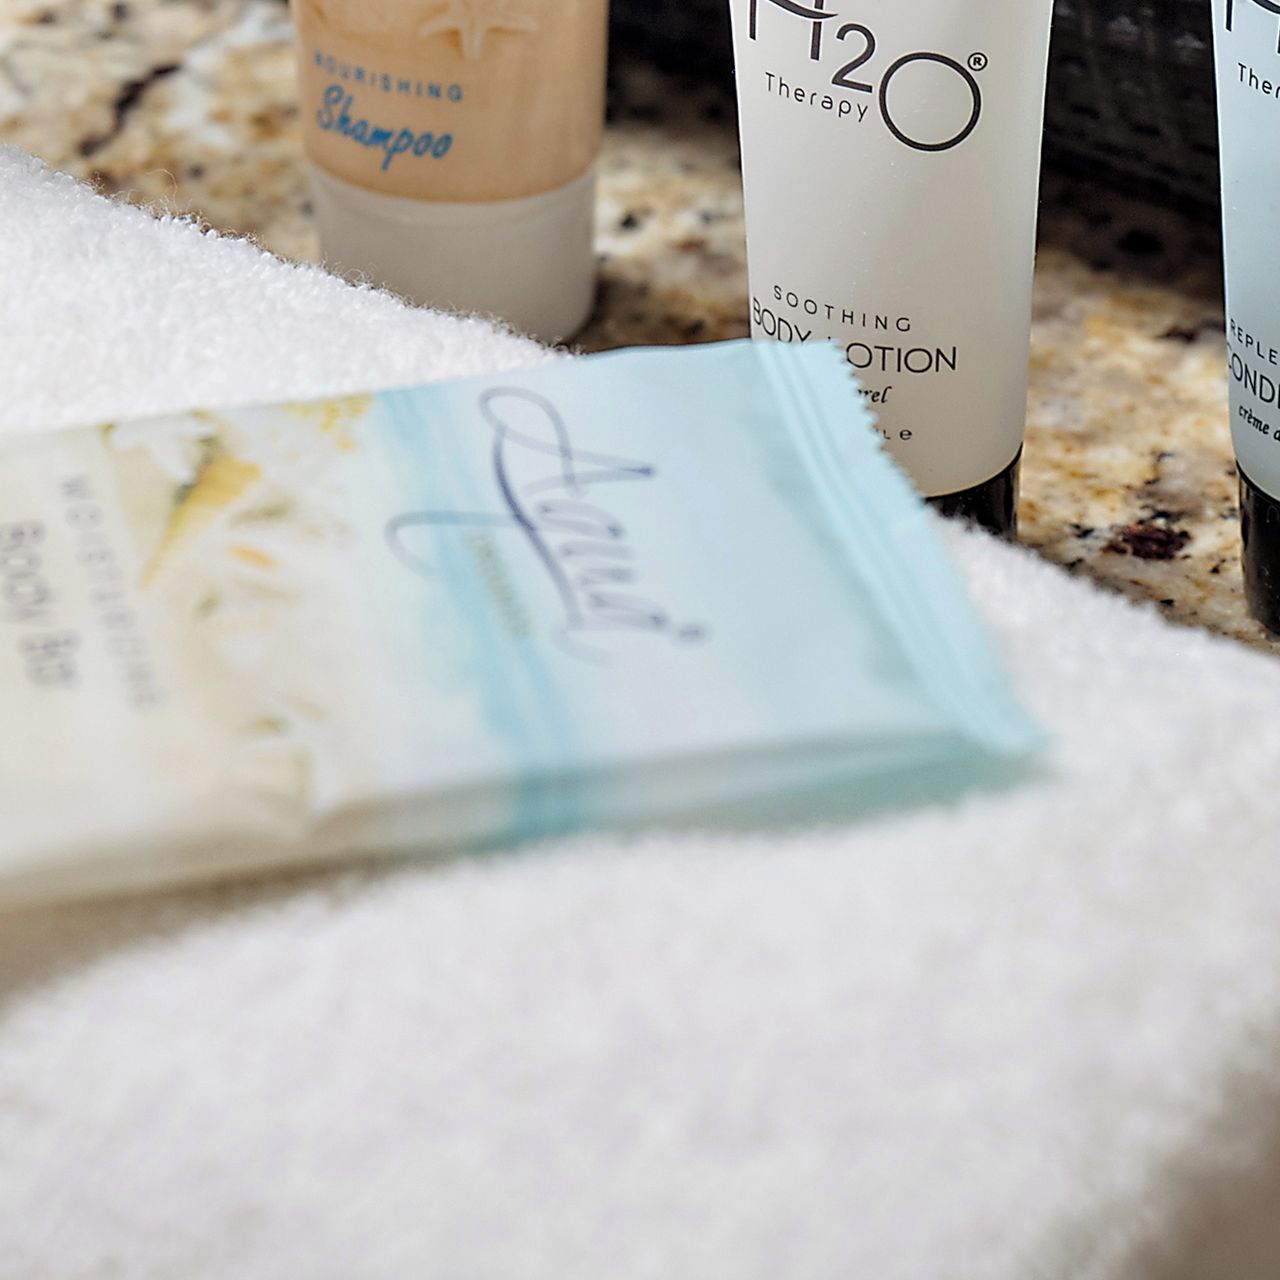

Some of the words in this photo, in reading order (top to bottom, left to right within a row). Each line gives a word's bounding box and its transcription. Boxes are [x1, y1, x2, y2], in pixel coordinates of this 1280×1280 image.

[314, 50, 464, 104] NOURISHING
[765, 71, 869, 123] Therapy
[316, 83, 454, 173] Shampoo
[773, 284, 912, 332] SOOTHING
[845, 342, 957, 373] OTION
[1238, 404, 1271, 435] crème
